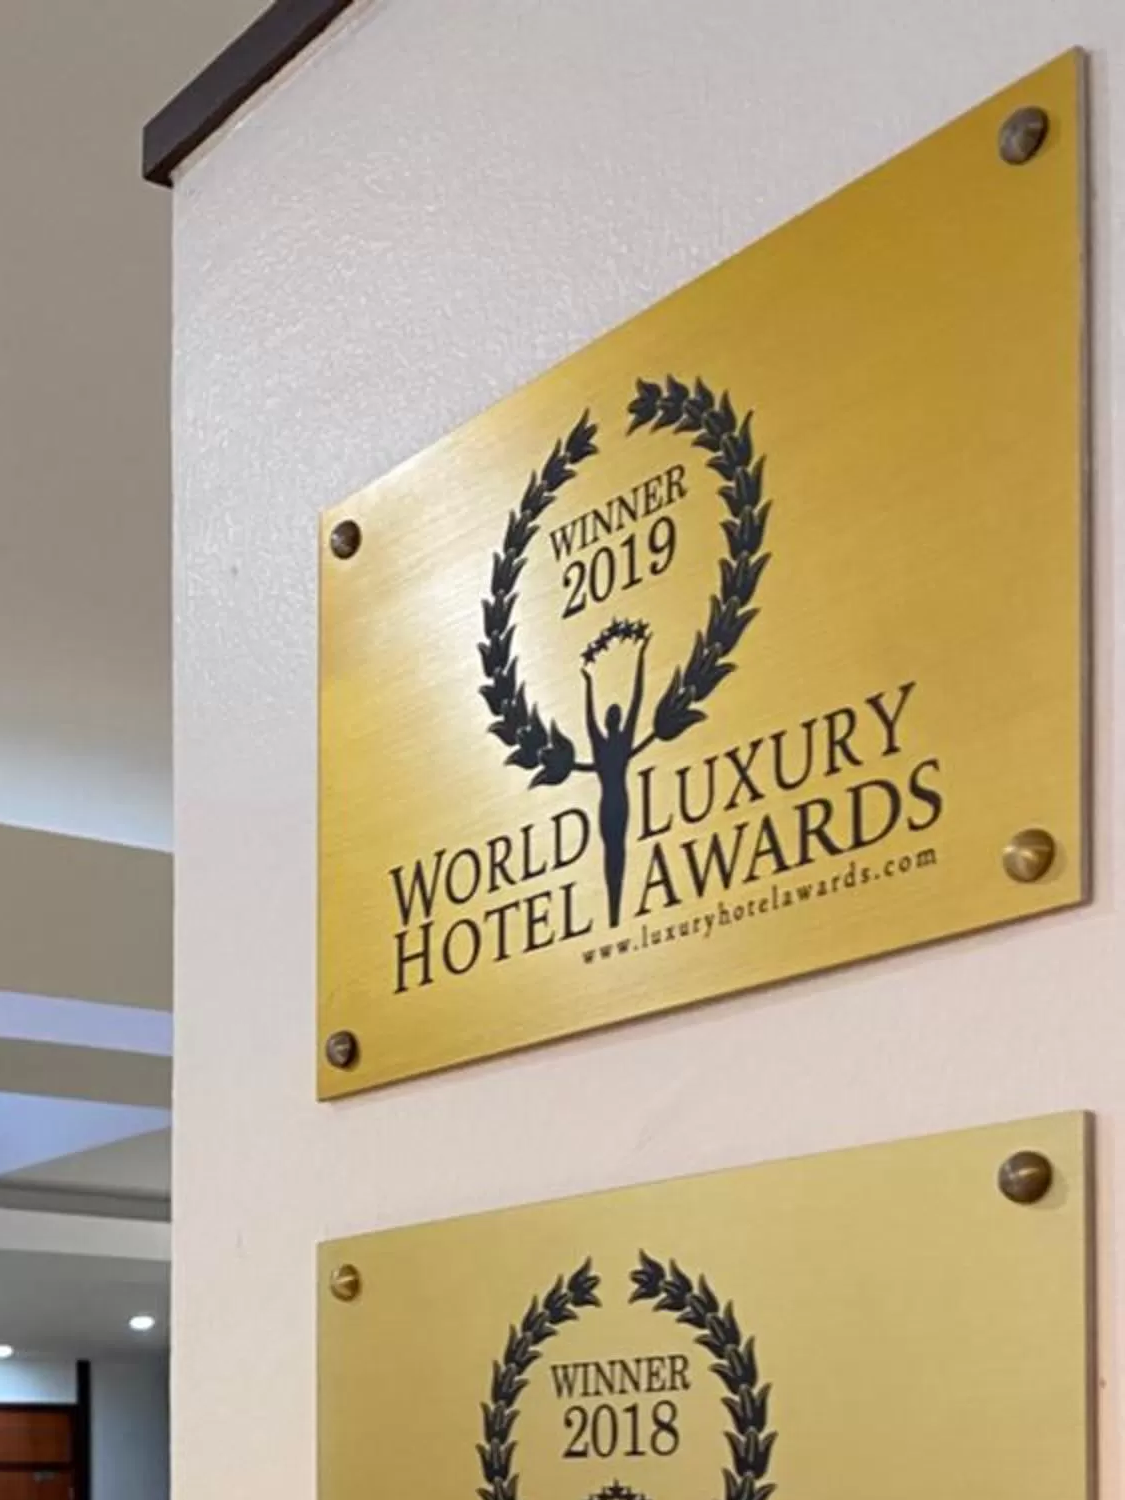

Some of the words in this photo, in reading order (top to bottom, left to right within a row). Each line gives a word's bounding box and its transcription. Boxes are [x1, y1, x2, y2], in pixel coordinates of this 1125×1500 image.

[550, 463, 689, 562] WINNER
[561, 516, 677, 618] 2019
[390, 808, 590, 926] WORLD
[638, 682, 916, 840] LUXURY
[392, 882, 594, 994] HOTEL
[634, 759, 943, 917] AWARDS
[581, 849, 939, 966] www.luxuryhotelawards.com
[551, 1353, 691, 1400] WINNER
[562, 1400, 680, 1459] 2018
